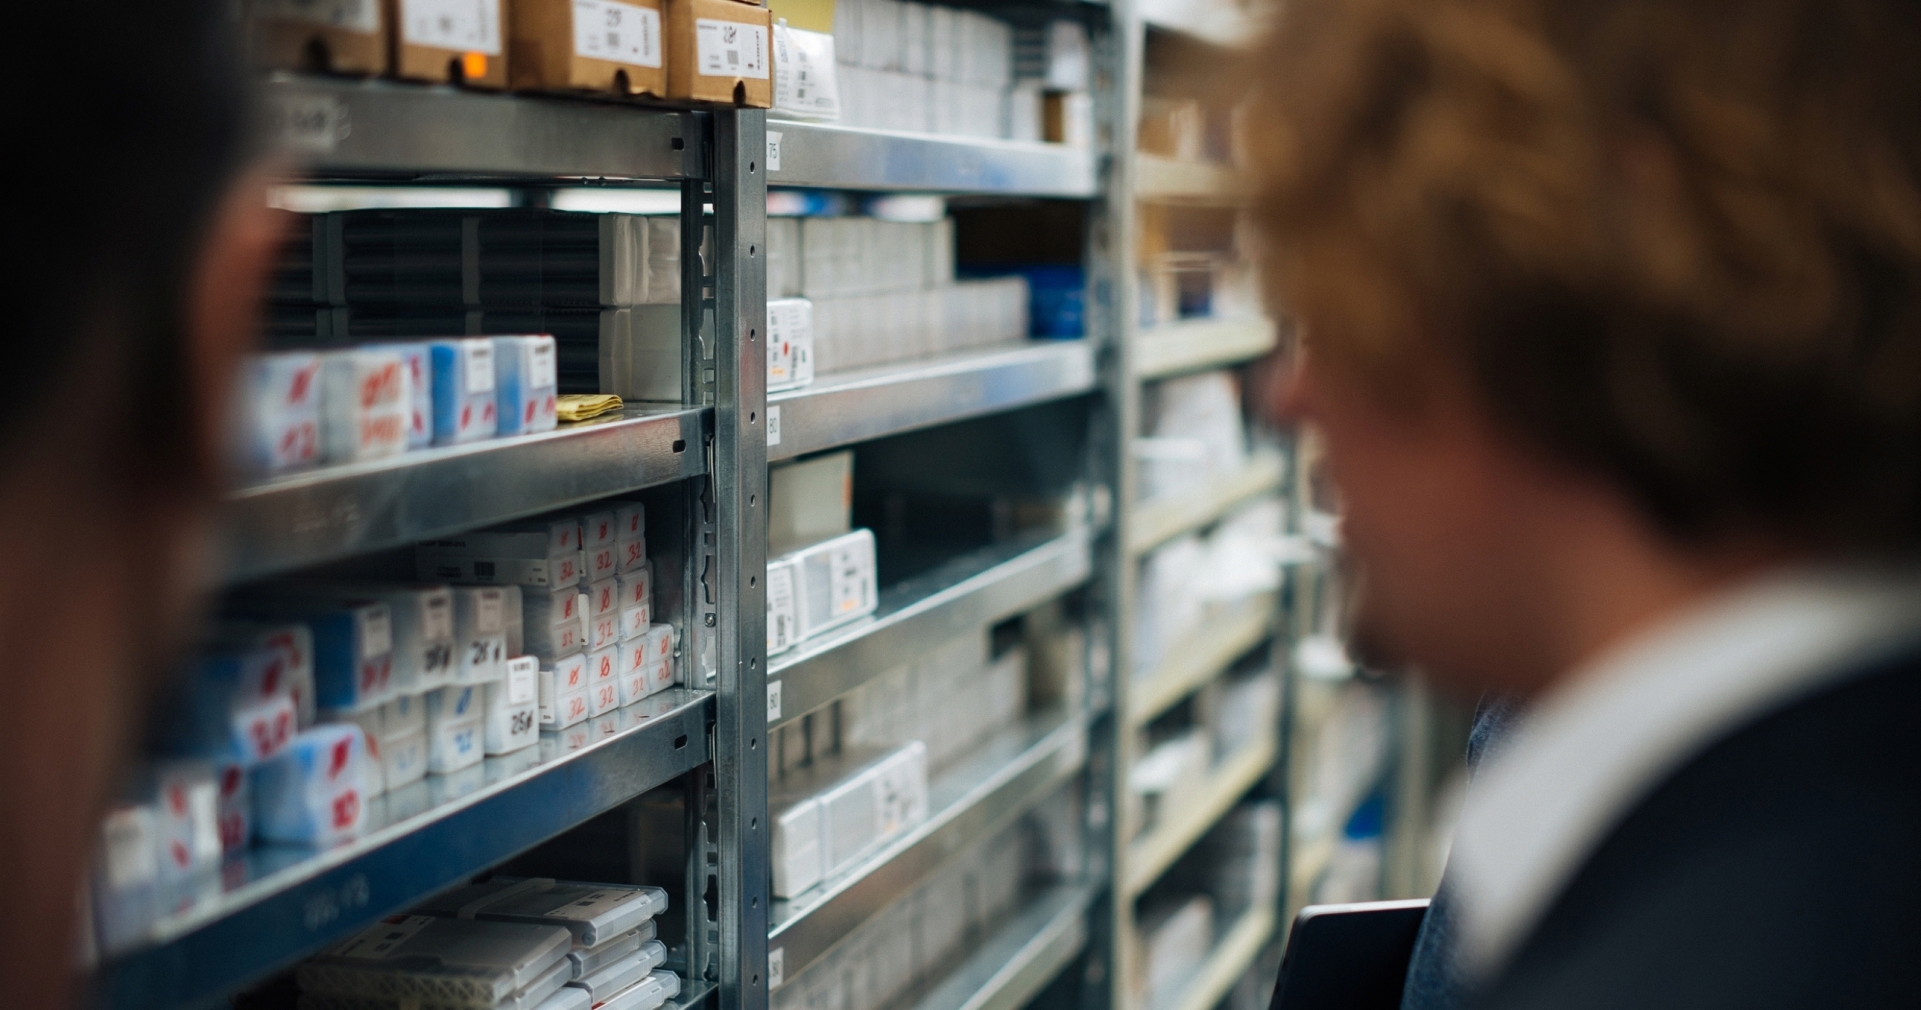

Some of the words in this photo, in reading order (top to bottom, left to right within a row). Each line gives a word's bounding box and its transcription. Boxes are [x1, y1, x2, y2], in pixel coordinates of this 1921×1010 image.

[597, 551, 613, 570] 32
[626, 541, 642, 566] 32
[560, 560, 574, 581] 32
[634, 608, 647, 628] 32
[596, 620, 613, 646] 32
[599, 685, 614, 708] 32
[633, 677, 644, 696] 32
[568, 697, 586, 720] 32
